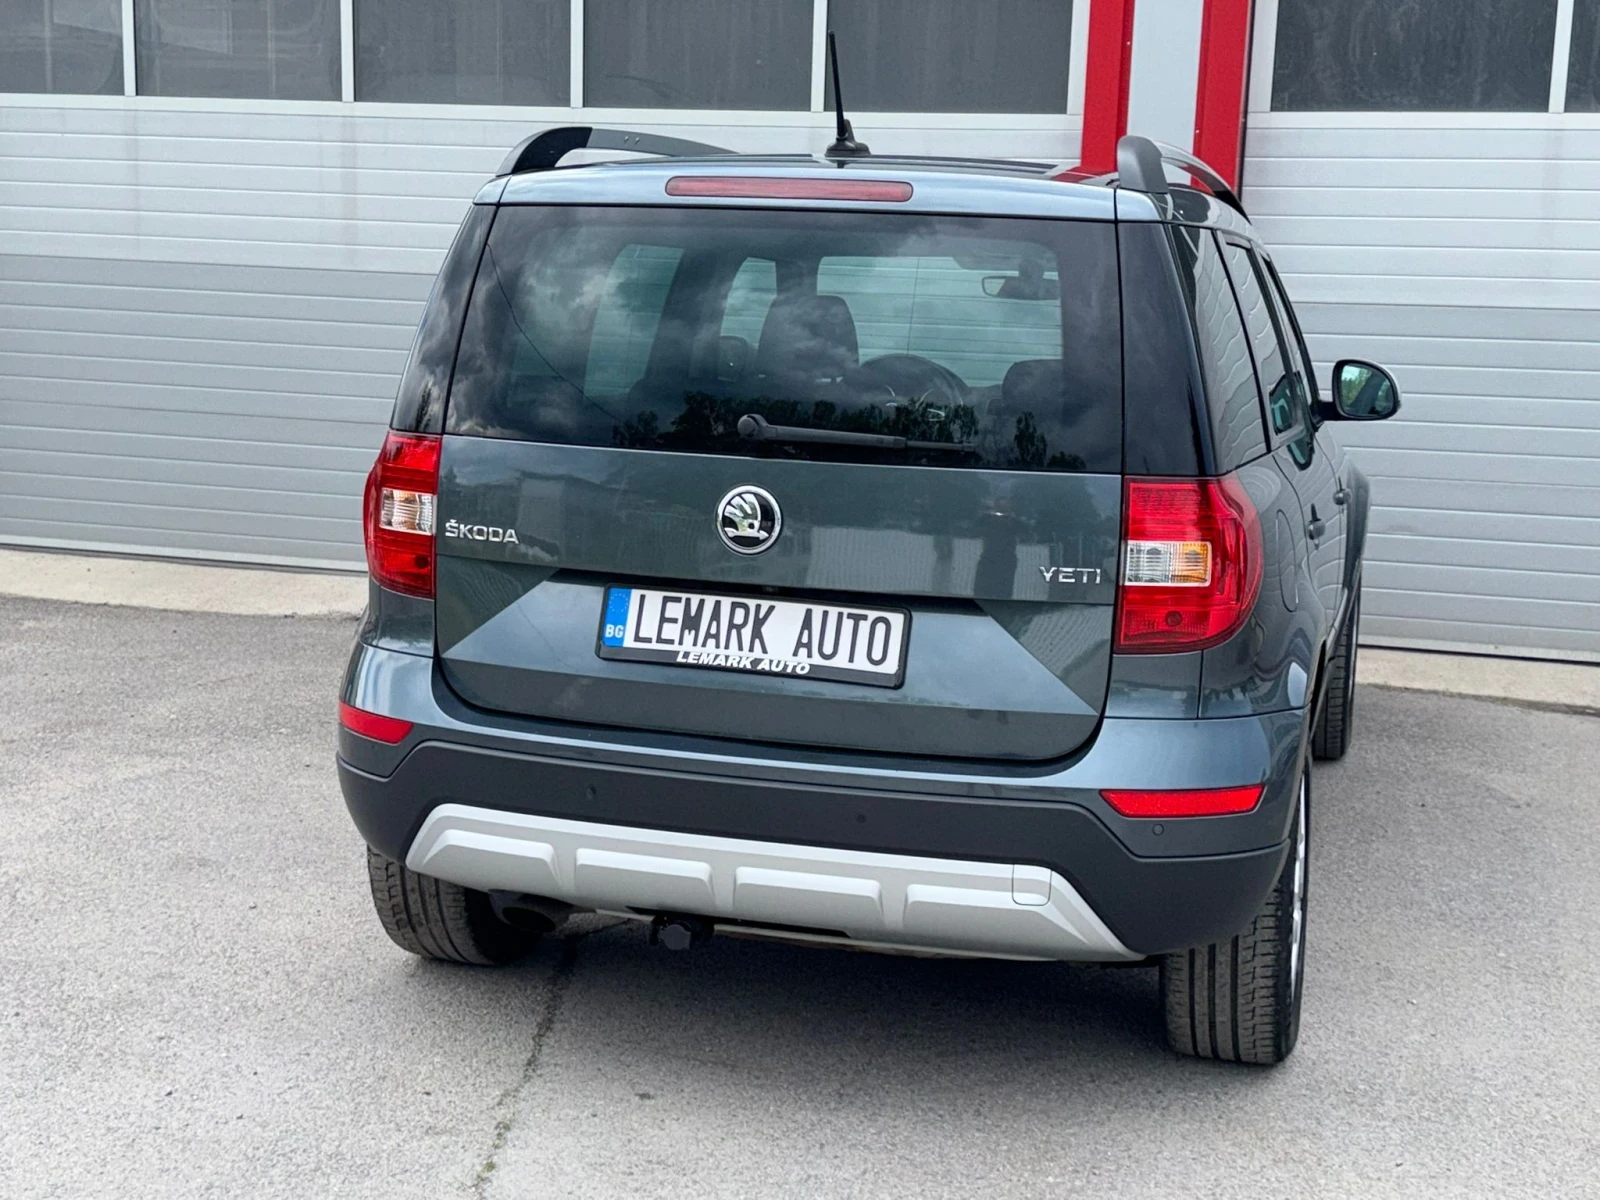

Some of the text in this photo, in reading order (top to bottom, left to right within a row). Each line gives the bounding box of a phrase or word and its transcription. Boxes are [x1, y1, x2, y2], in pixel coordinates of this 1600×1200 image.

[445, 519, 519, 544] ŠKODA
[1039, 566, 1101, 584] YETI
[605, 624, 624, 638] BG
[633, 593, 892, 666] LEMARK AUTO
[676, 651, 810, 675] LEMARK AUTO
